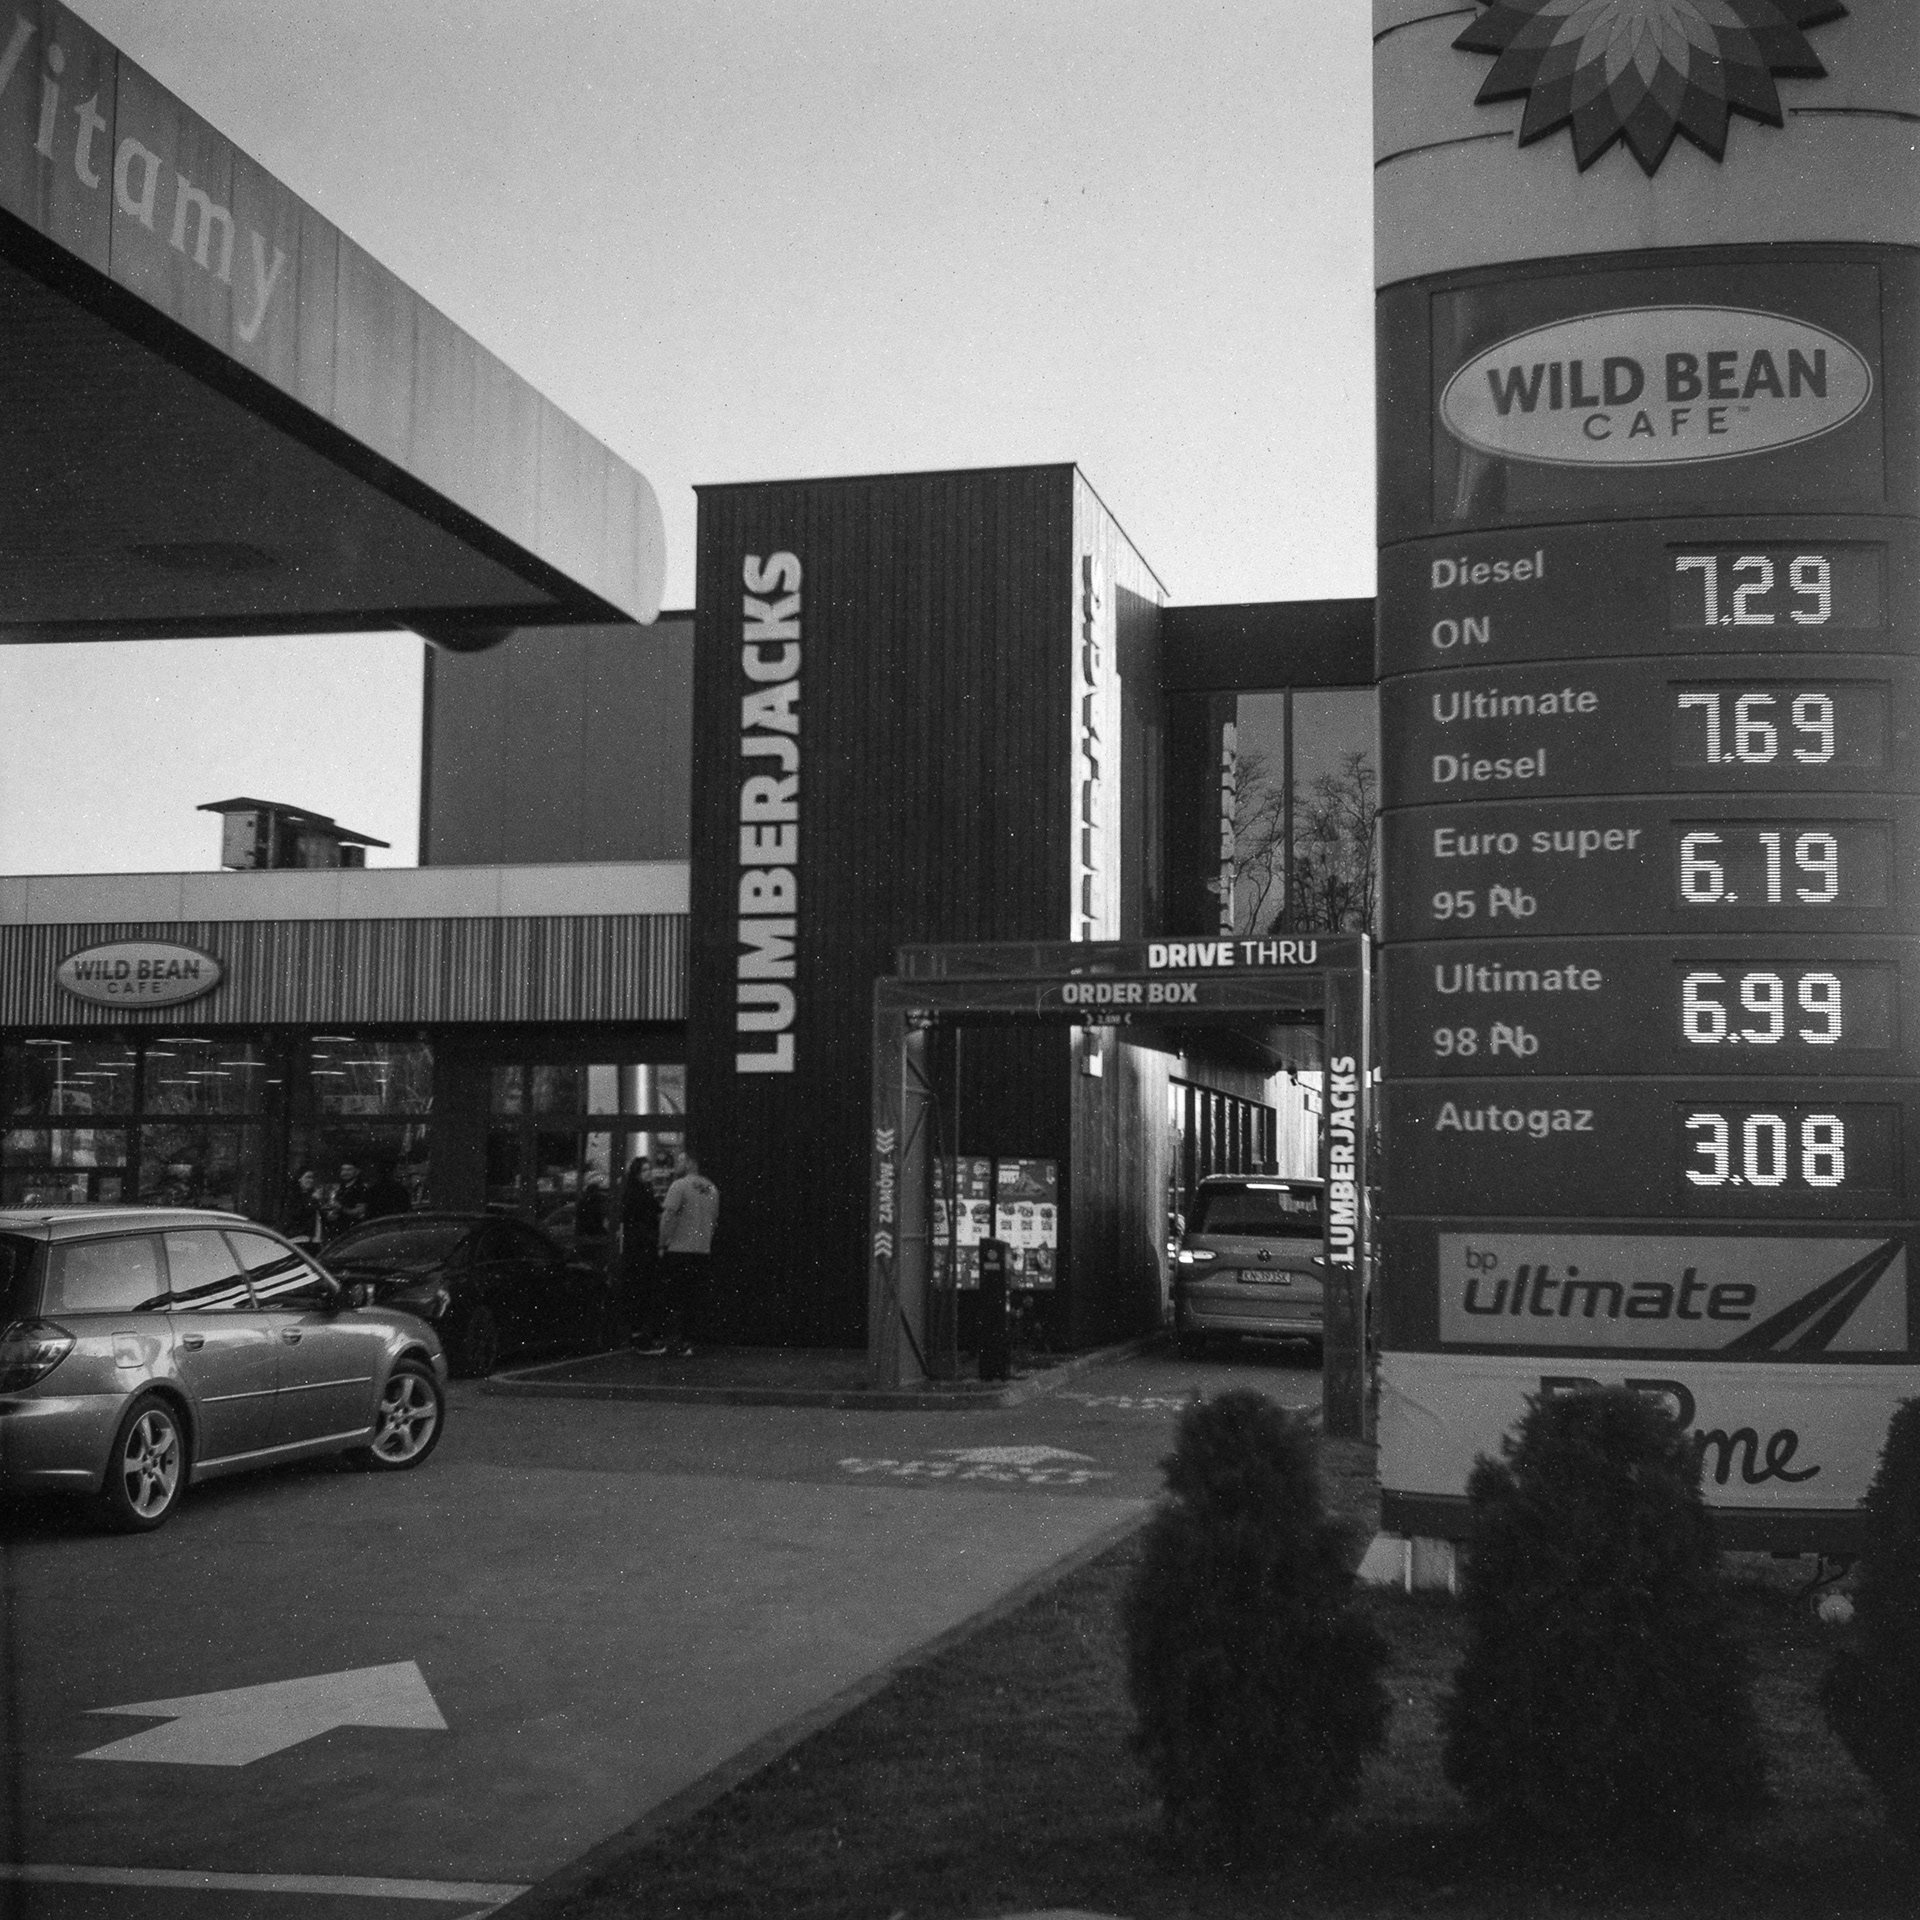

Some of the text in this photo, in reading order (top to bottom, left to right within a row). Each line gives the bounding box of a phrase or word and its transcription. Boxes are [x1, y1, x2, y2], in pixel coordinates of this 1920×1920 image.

[1487, 348, 1828, 416] WILD BEAN
[1583, 406, 1728, 441] CAFE
[1431, 550, 1545, 588] Diesel
[1675, 556, 1832, 626] 7.29
[1431, 617, 1491, 649] ON
[1433, 688, 1599, 721] Ultimate
[1678, 693, 1835, 763] 7.69
[1432, 748, 1546, 783] Diesel
[736, 551, 802, 1073] LUMBERJACKS
[1433, 826, 1641, 858] Euro super
[1680, 832, 1839, 902] 6.19
[1432, 890, 1476, 920] 95
[74, 959, 200, 981] WILD BEAN
[1148, 940, 1317, 968] DRIVE THRU
[107, 981, 162, 994] CAFE
[1062, 982, 1198, 1004] ORDER BOX
[1435, 963, 1602, 993] Ultimate
[1683, 973, 1842, 1044] 6.99
[1433, 1028, 1477, 1056] 98
[1435, 1102, 1594, 1138] Autogaz
[1329, 1056, 1356, 1265] LUMBERJACKS
[1685, 1113, 1845, 1187] 3.08
[876, 1162, 894, 1223] ZAMÓW
[1465, 1246, 1498, 1274] bp
[1463, 1264, 1757, 1321] ultimate
